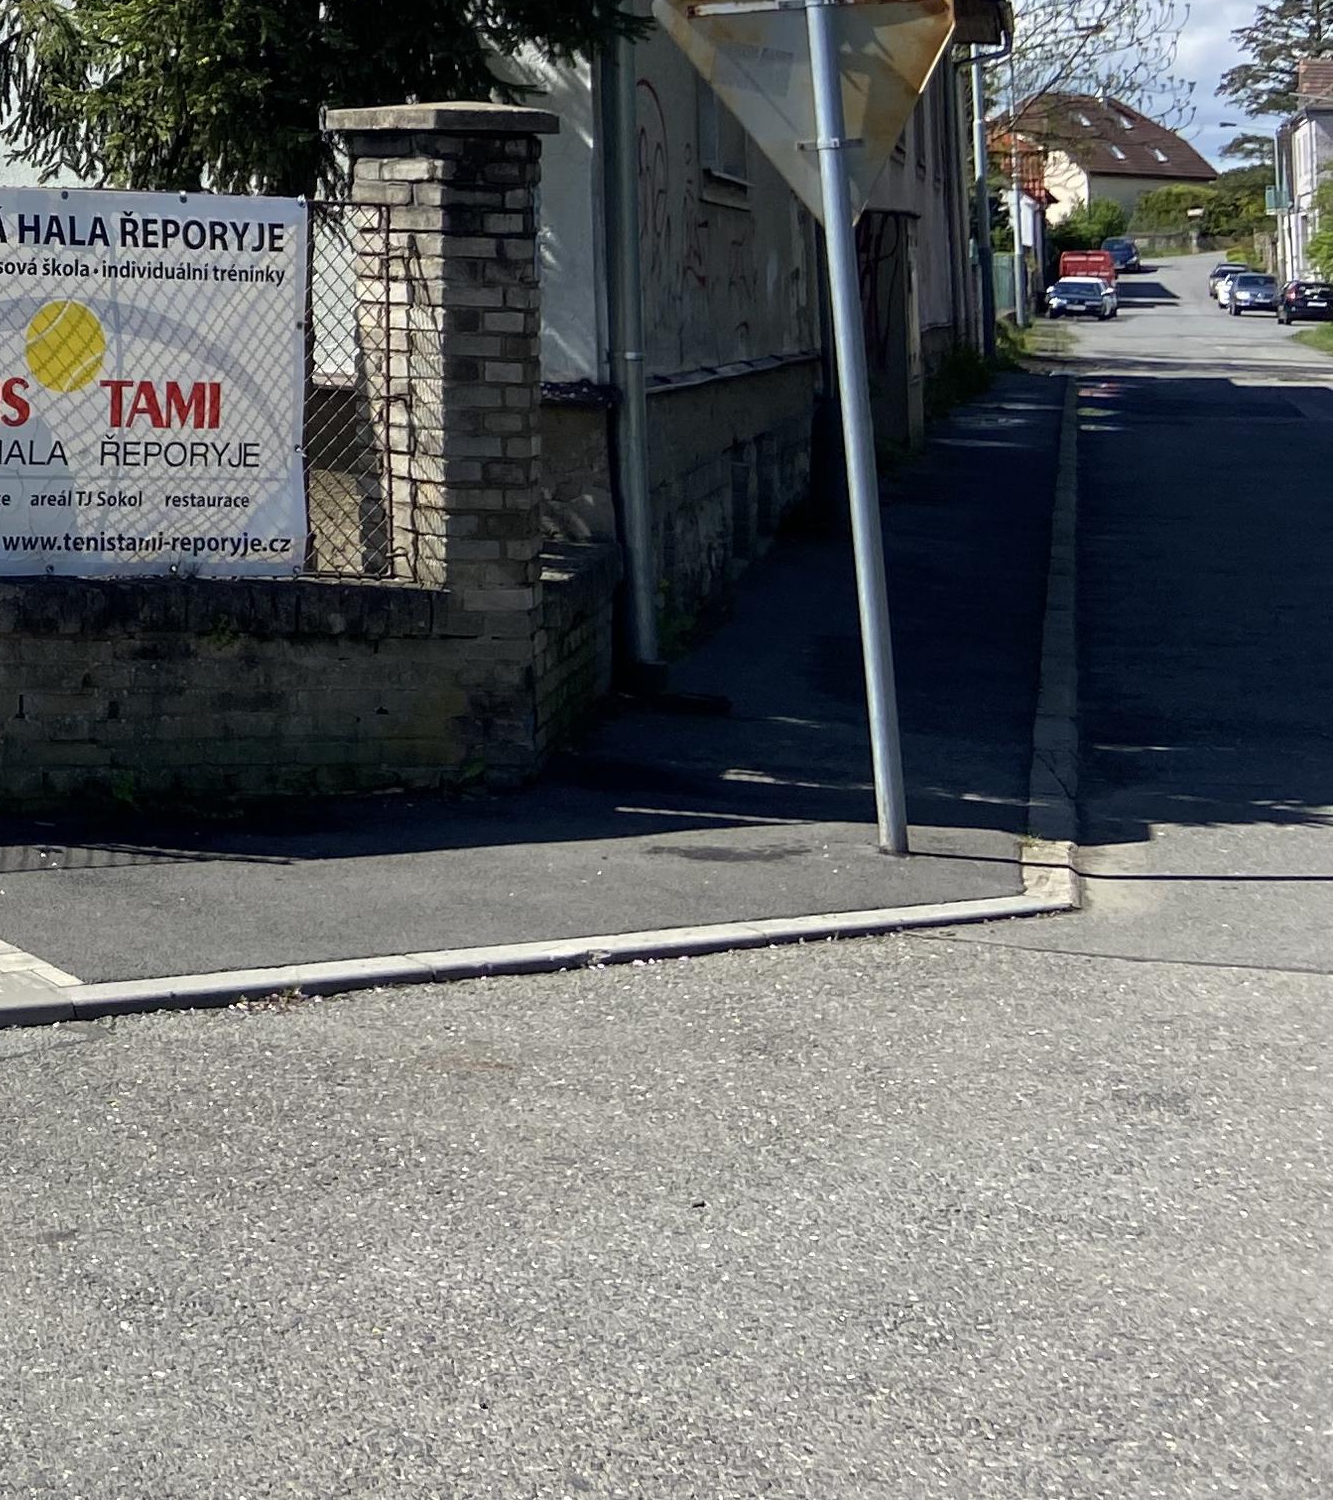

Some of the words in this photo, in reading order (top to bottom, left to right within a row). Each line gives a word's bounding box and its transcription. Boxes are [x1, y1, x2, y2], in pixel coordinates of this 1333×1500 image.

[18, 213, 110, 247] HALA
[120, 211, 285, 252] ŘEPORYJE
[42, 257, 90, 277] škola
[102, 260, 208, 281] individuální
[212, 263, 286, 287] tréninky
[100, 379, 222, 429] TAMI
[99, 434, 260, 468] ŘEPORYJE
[30, 490, 72, 507] areál
[76, 491, 92, 507] TJ
[97, 490, 143, 507] Sokol
[165, 493, 250, 508] restaurace
[2, 531, 292, 557] www.tenistami-reporyje.cz
